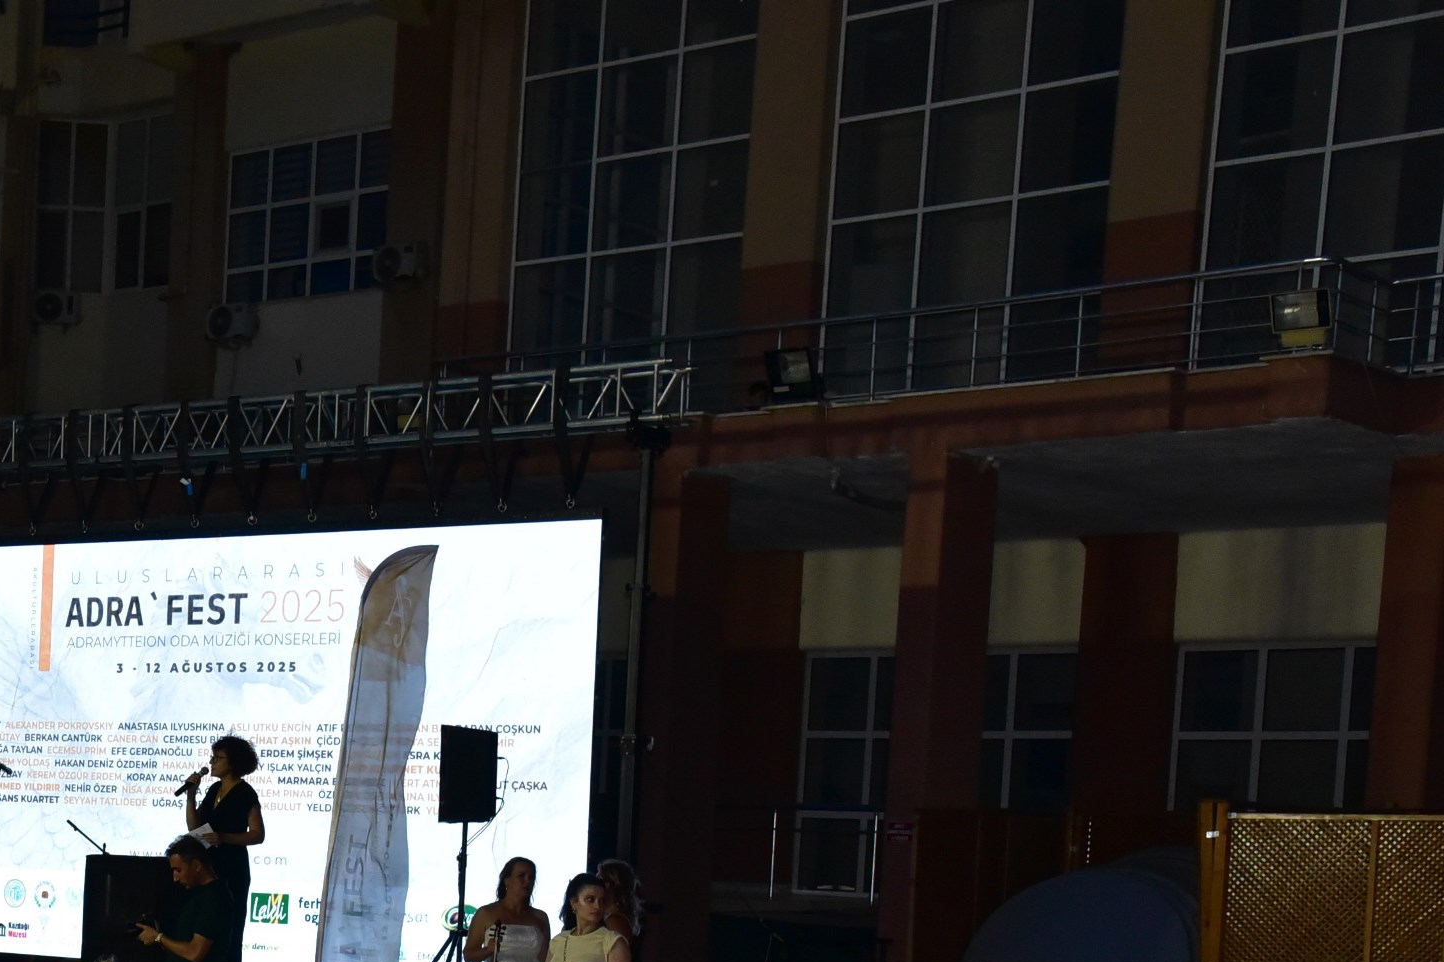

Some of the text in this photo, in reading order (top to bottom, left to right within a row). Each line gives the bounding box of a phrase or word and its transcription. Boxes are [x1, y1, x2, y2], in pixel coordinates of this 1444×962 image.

[71, 561, 344, 585] ULUSLARARASI
[260, 589, 345, 624] 2025
[67, 628, 341, 649] ADRAMYTTEION ODA MÜZİĞİ KONSERLERİ
[116, 663, 124, 673] 3
[146, 663, 161, 673] 12
[169, 659, 247, 673] AĞUSTOS
[256, 662, 297, 673] 2025
[5, 721, 56, 730] ALEXANDER
[57, 722, 113, 730] POKROVSKIY
[118, 722, 168, 731] ANASTASIA
[170, 722, 225, 731] ILYUSHKINA
[253, 723, 278, 732] UTKU
[281, 720, 311, 732] ENGİN
[317, 723, 338, 732] ATIF
[496, 725, 541, 736] COŞKUN
[24, 733, 59, 742] BERKAN
[61, 732, 102, 743] CANTÜRK
[107, 734, 137, 743] CANER
[139, 735, 158, 744] CAN
[162, 735, 207, 744] CEMRESU
[281, 737, 311, 747] AŞKIN
[11, 745, 43, 754] TAYLAN
[47, 746, 82, 755] ECEMSU
[111, 747, 127, 756] EFE
[129, 746, 193, 757] GERDANOĞLU
[260, 748, 333, 761] ERDEM ŞİMŞEK
[17, 757, 50, 768] YOLDAŞ
[54, 758, 85, 768] HAKAN
[87, 757, 114, 768] DENİZ
[116, 758, 158, 770] ÖZDEMİR
[162, 761, 194, 770] HAKAN
[297, 764, 332, 775] YALÇIN
[26, 771, 56, 779] KEREM
[58, 769, 88, 780] ÖZGÜR
[91, 772, 122, 781] ERDEM
[126, 772, 158, 782] KORAY
[159, 774, 185, 784] ANAÇ
[277, 776, 329, 786] MARMARA
[64, 782, 91, 793] NEHİR
[93, 783, 117, 793] ÖZER
[122, 783, 142, 794] NİSA
[511, 781, 548, 793] ÇAŞKA
[284, 789, 313, 798] PINAR
[20, 795, 59, 804] KUARTET
[63, 796, 98, 805] SEYYAH
[99, 797, 147, 806] TATLIDEDE
